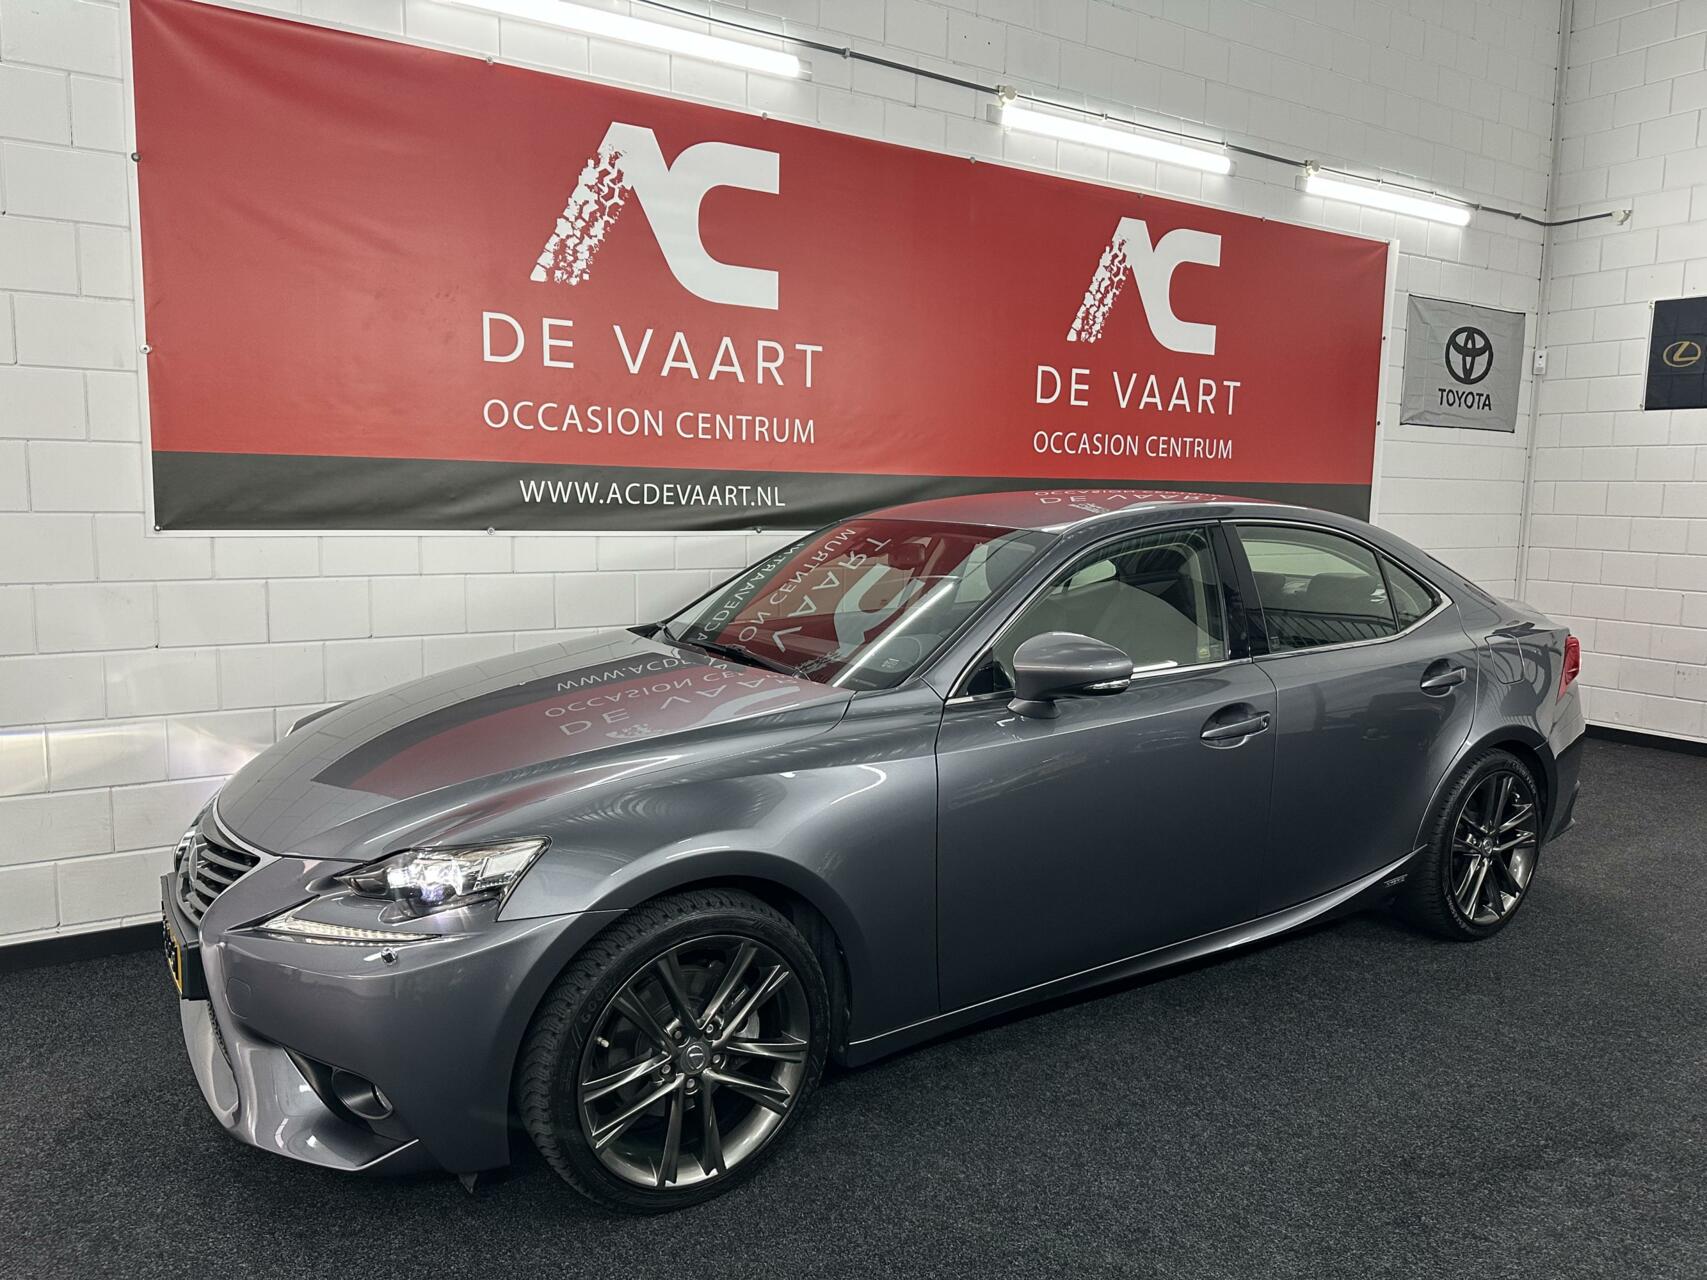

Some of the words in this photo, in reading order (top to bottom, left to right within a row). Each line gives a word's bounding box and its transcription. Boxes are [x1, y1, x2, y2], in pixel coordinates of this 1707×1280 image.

[530, 121, 780, 310] AC
[1066, 216, 1222, 356] AC
[482, 311, 574, 369] DE
[613, 324, 823, 388] VAART
[1036, 365, 1090, 406] DE
[1112, 371, 1241, 416] VAART
[1438, 388, 1492, 411] TOYOTA
[483, 399, 663, 437] OCCASION
[676, 411, 815, 444] CENTRUM
[1033, 430, 1139, 456] OCCASION
[1145, 435, 1233, 459] CENTRUM
[519, 479, 786, 507] WWW.ACDEVAART.NL
